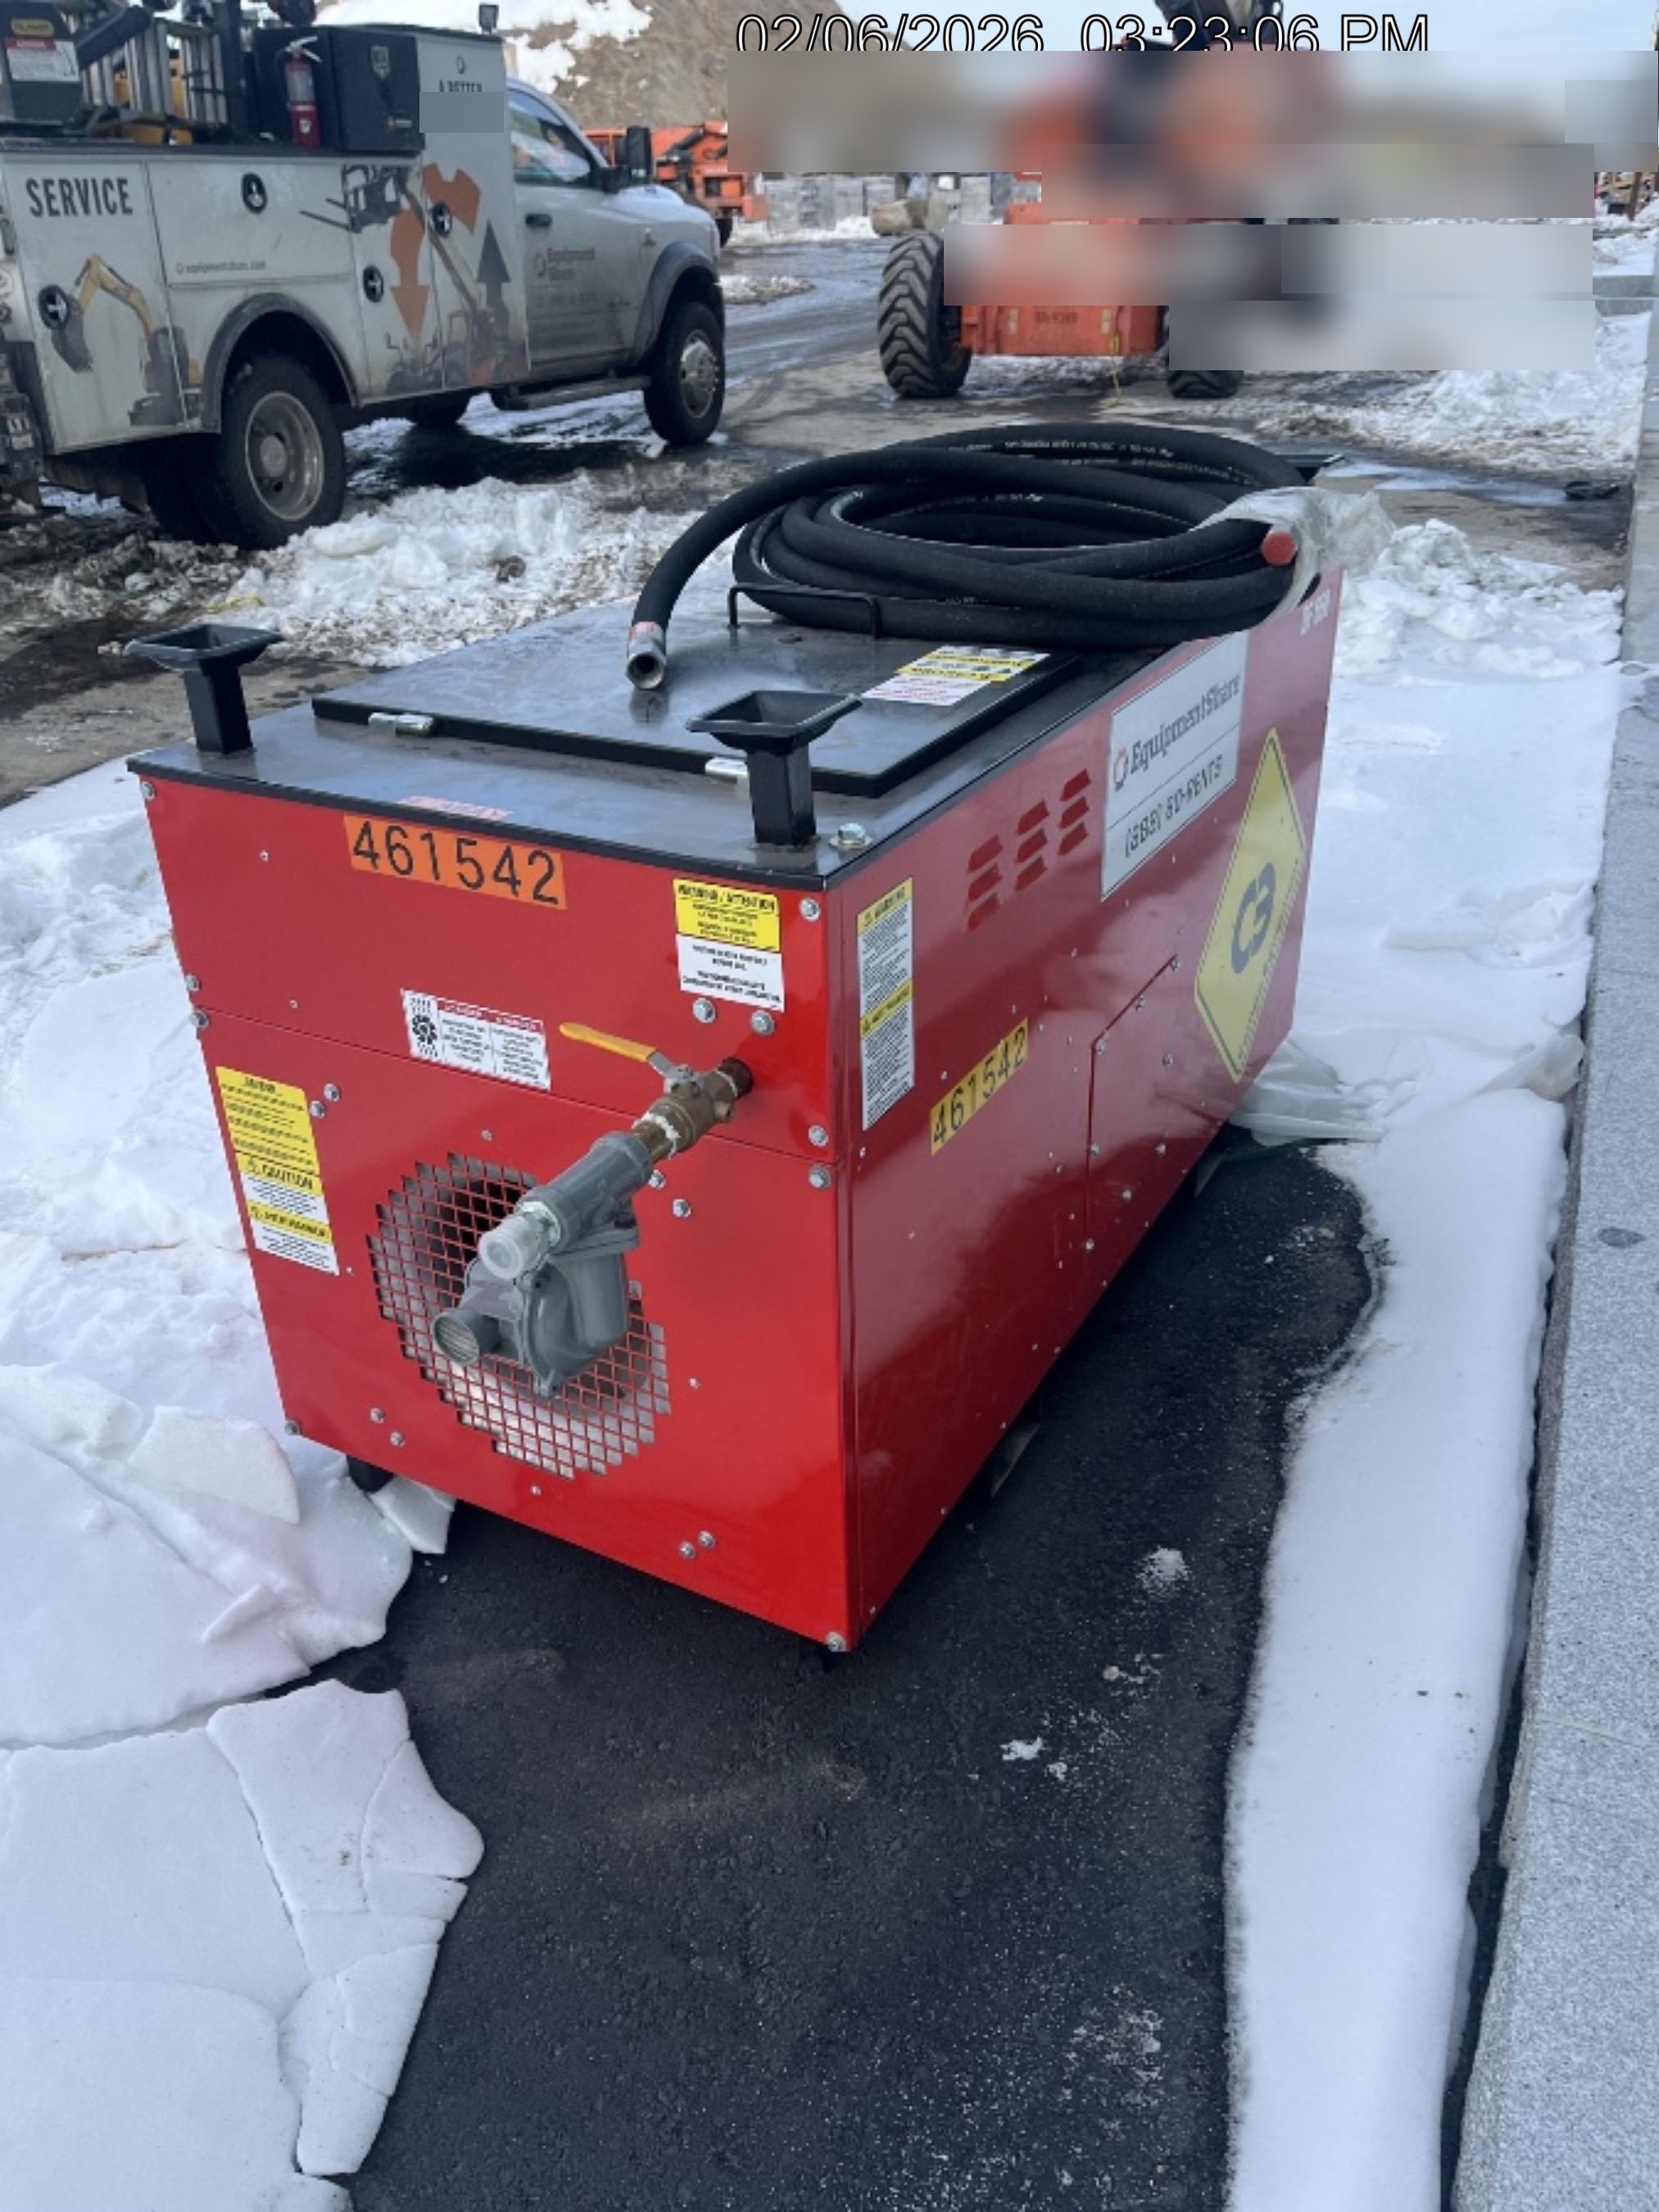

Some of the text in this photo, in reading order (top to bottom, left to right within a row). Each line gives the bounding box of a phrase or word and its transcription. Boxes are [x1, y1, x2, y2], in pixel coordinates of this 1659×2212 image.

[25, 177, 133, 216] SERVICE
[1130, 674, 1241, 775] EquipmentShare
[353, 820, 559, 904] 461542
[934, 1027, 1025, 1143] 461542
